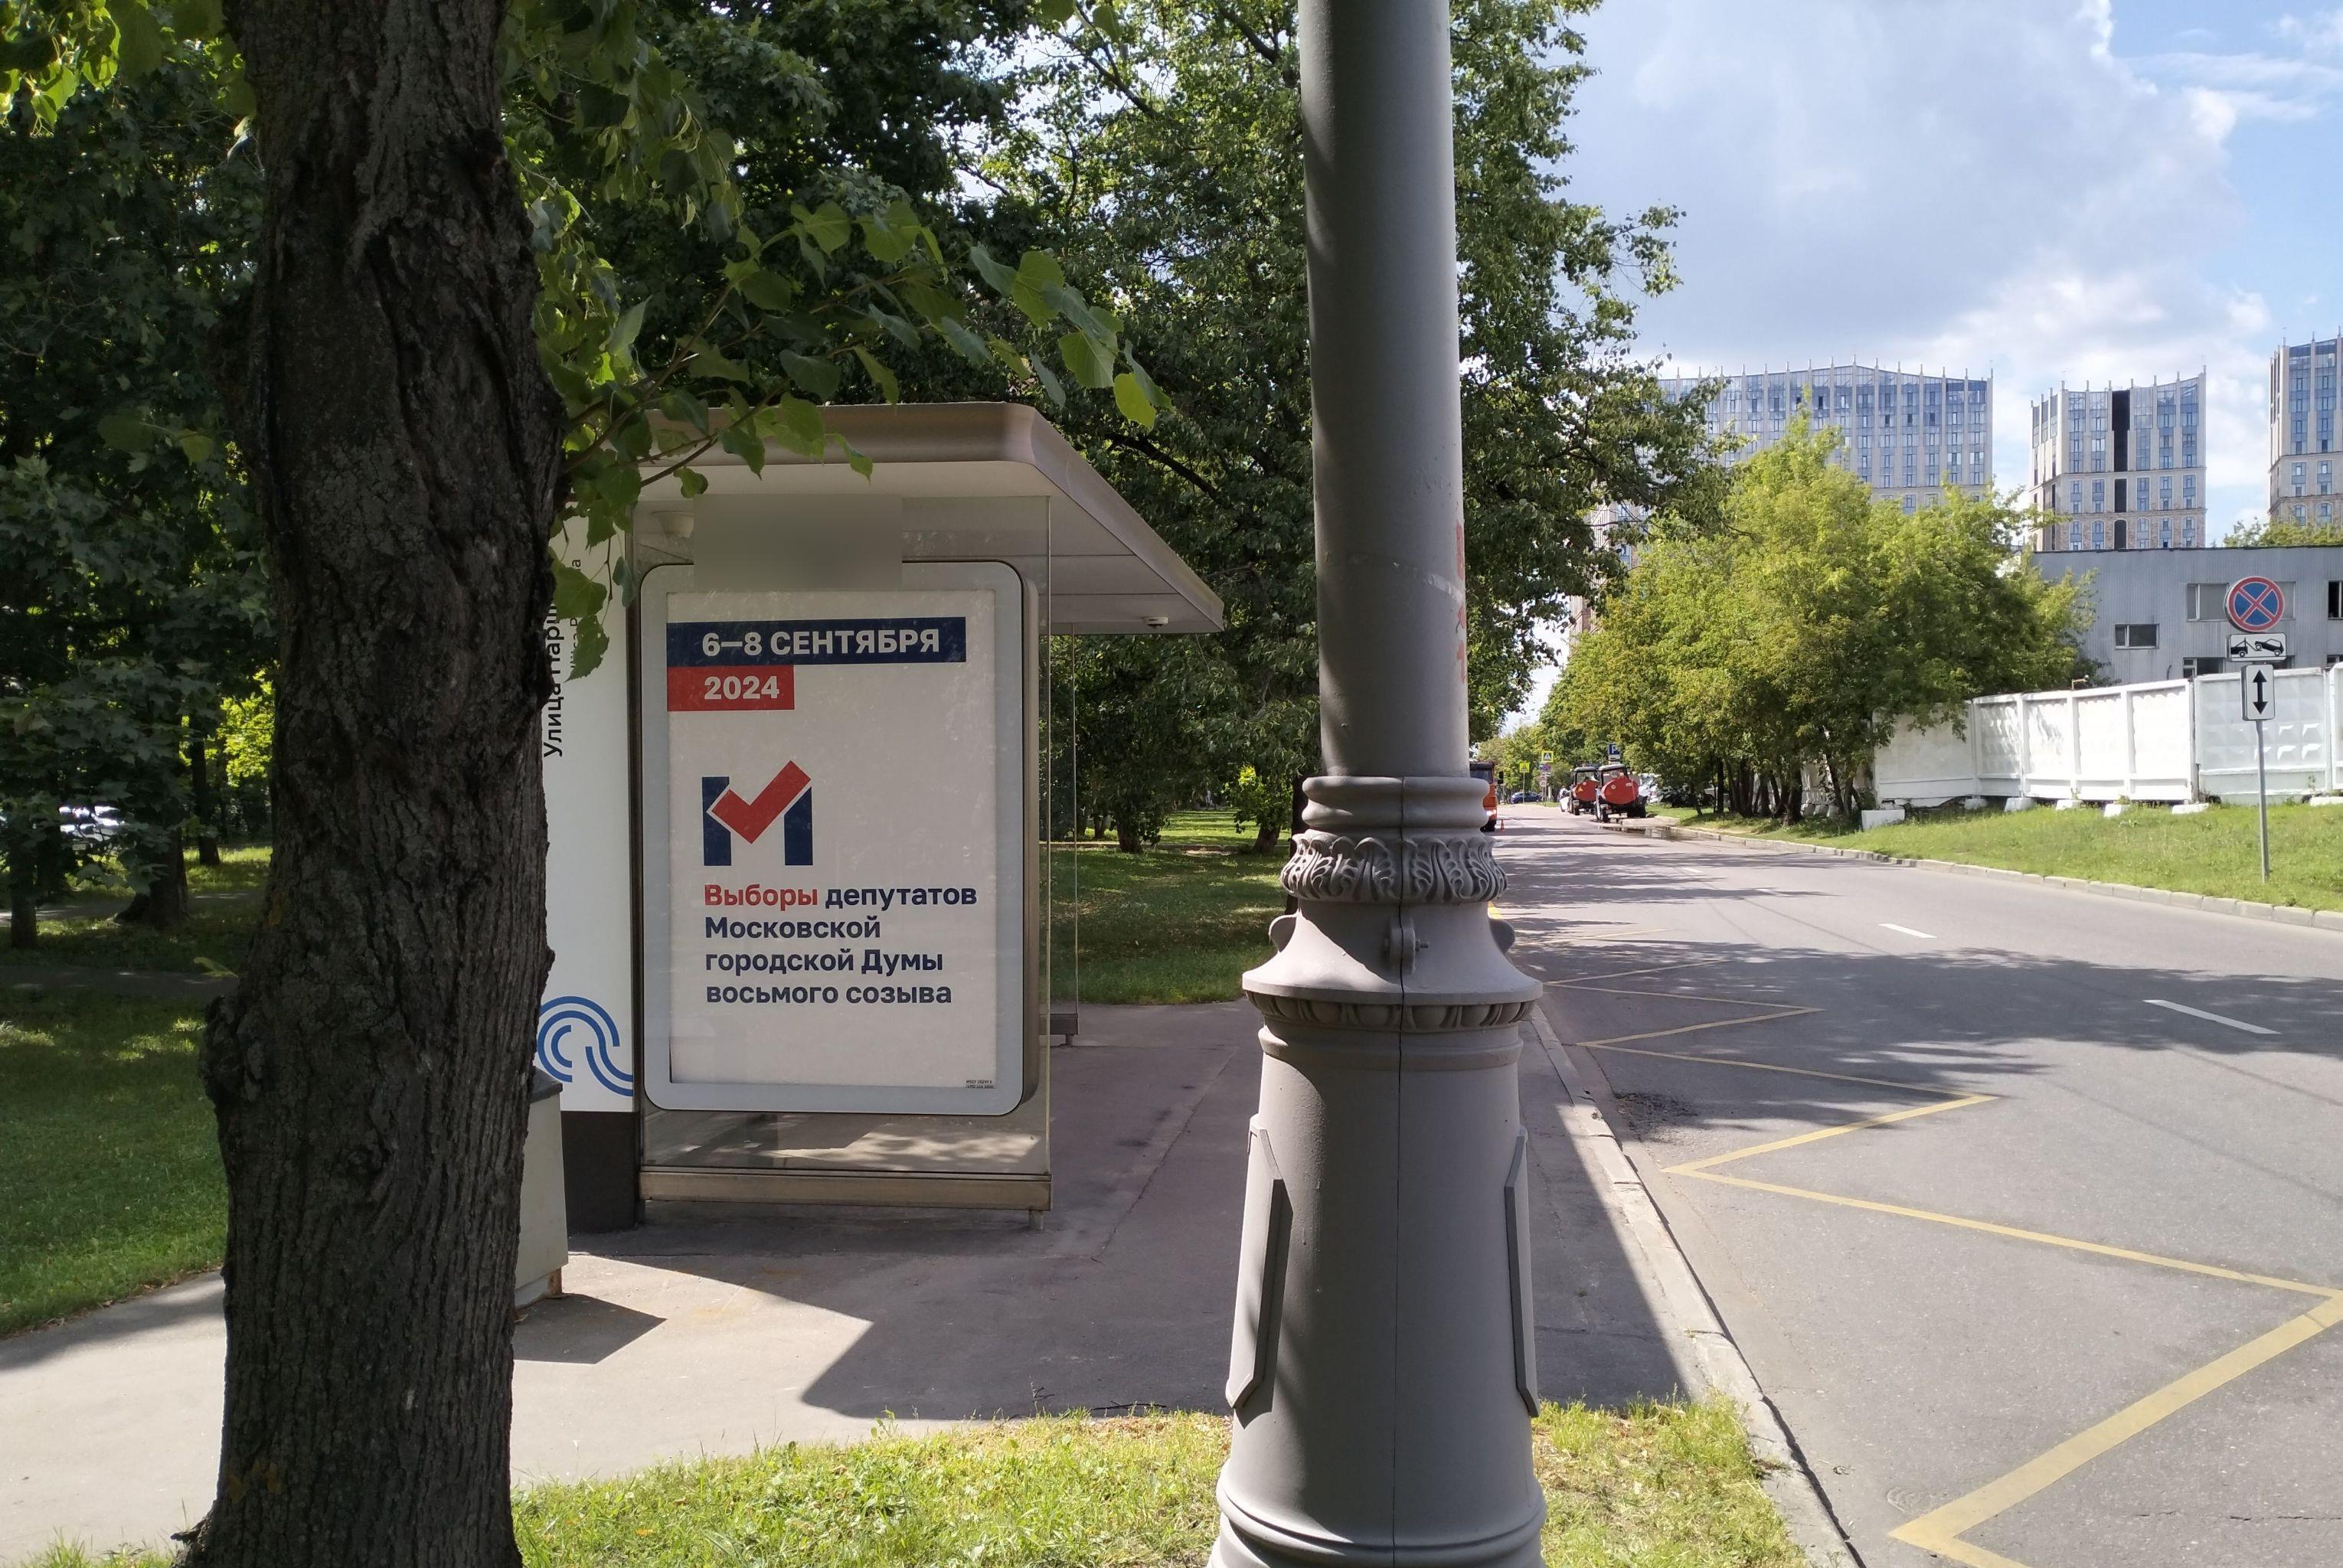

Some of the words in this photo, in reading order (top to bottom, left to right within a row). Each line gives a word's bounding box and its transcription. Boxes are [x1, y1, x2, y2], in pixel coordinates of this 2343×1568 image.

[770, 629, 939, 656] СЕНТЯБРЯ
[704, 675, 779, 700] 2024
[543, 683, 564, 758] Улица
[704, 884, 819, 911] Выборы
[825, 887, 977, 911] депутатов
[704, 915, 881, 939] Московской
[705, 948, 854, 976] городской
[861, 949, 943, 977] Думы
[706, 986, 838, 1004] восьмого
[845, 986, 952, 1004] созыва
